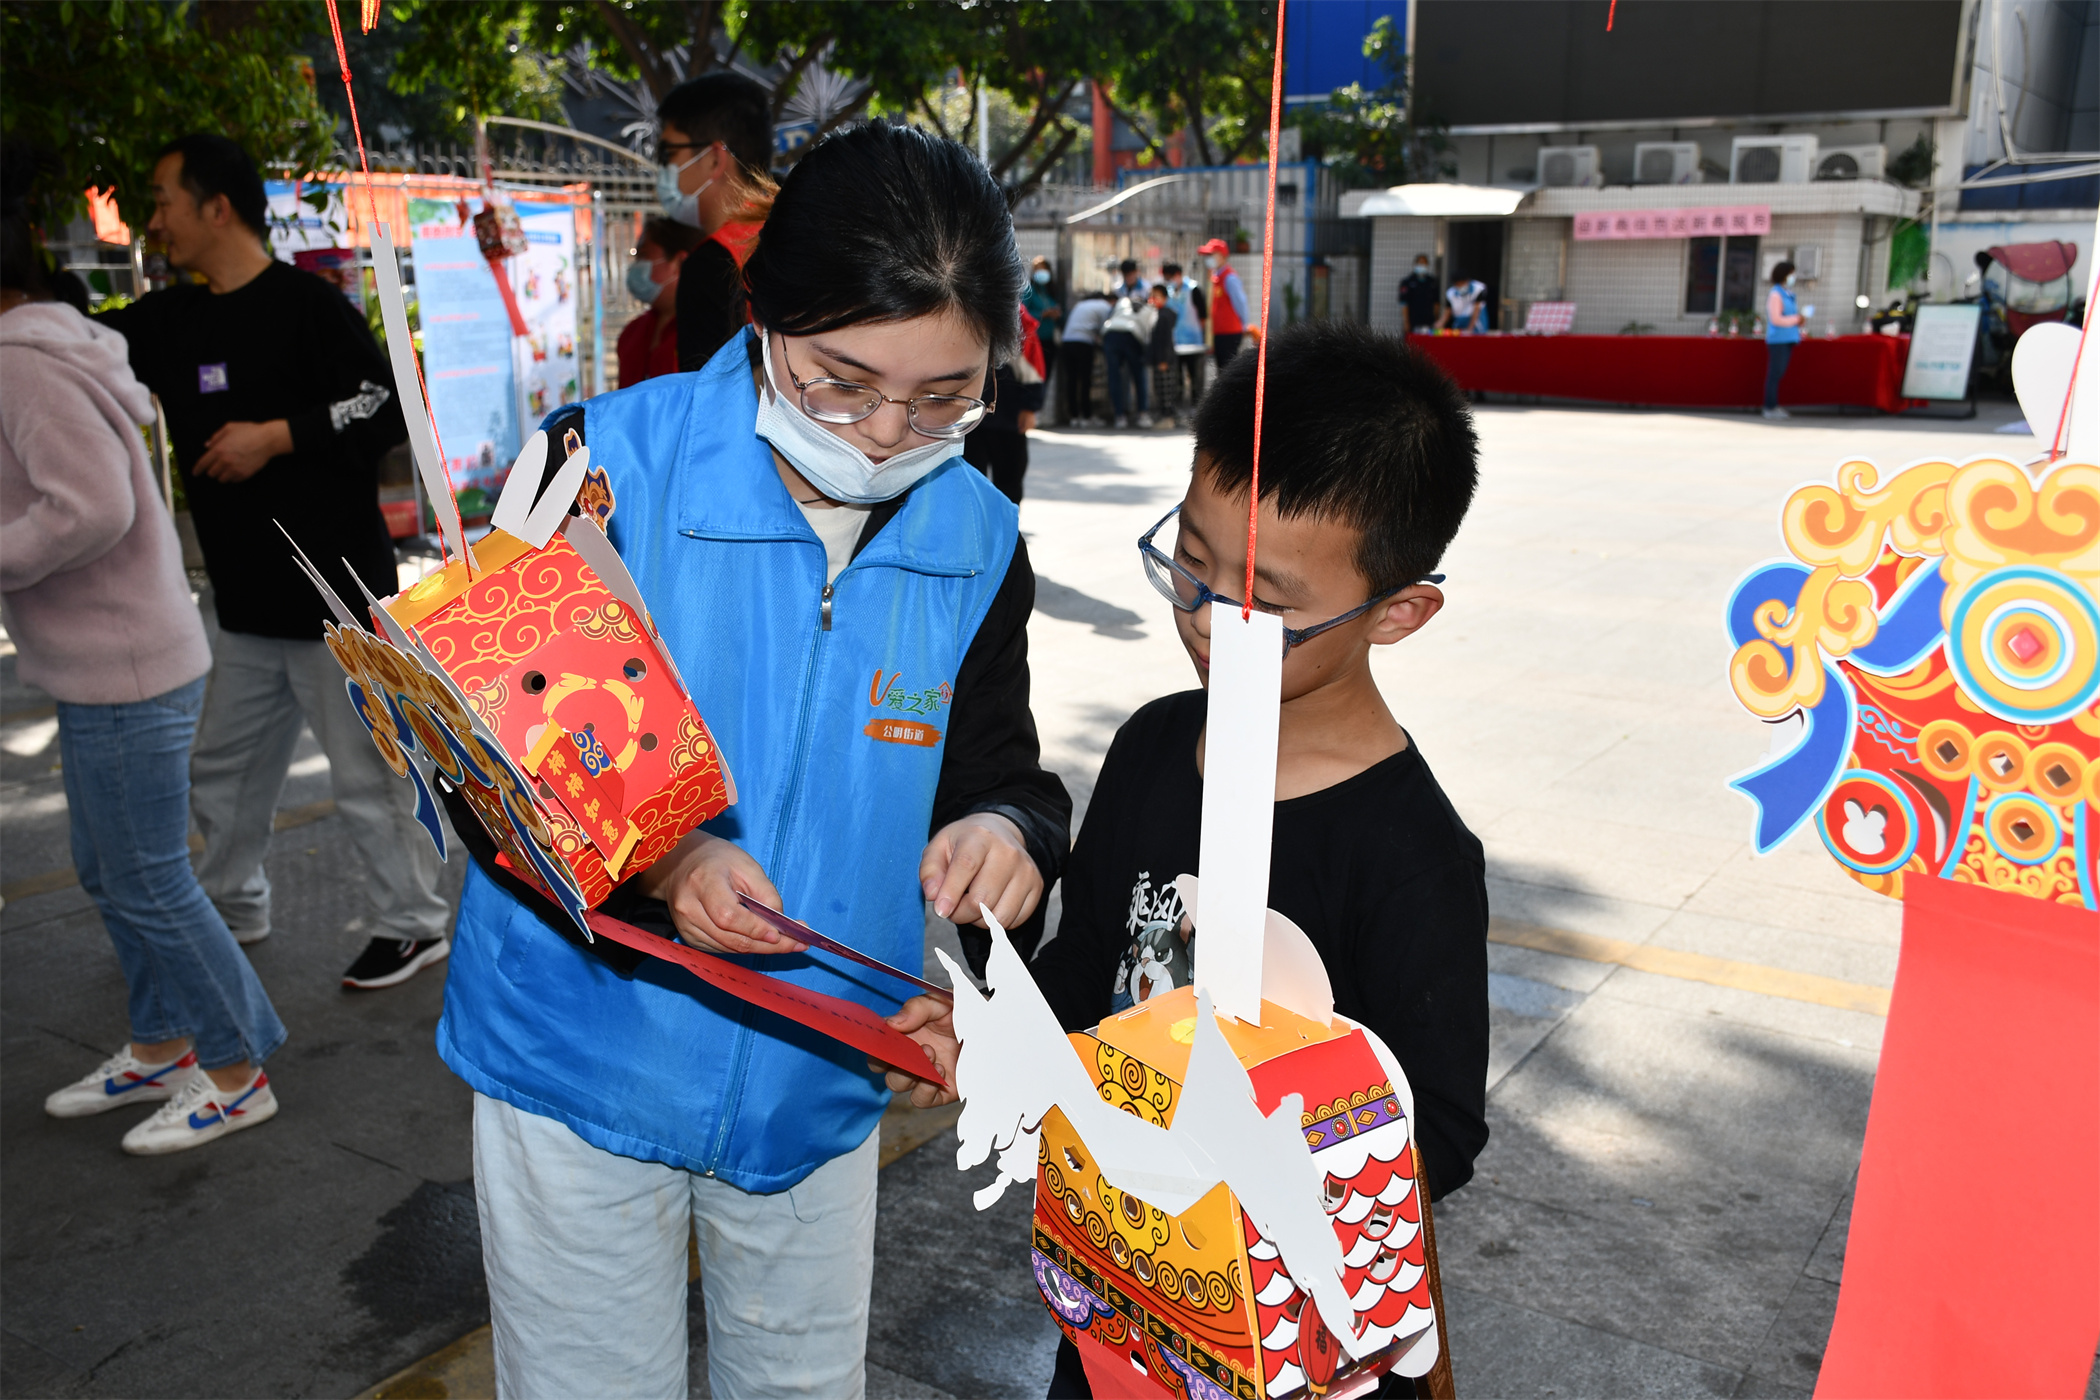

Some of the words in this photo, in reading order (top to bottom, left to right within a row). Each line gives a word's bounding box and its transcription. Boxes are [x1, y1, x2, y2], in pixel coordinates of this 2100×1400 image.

[883, 725, 925, 741] 公明街道
[546, 749, 620, 846] 柿柿如意
